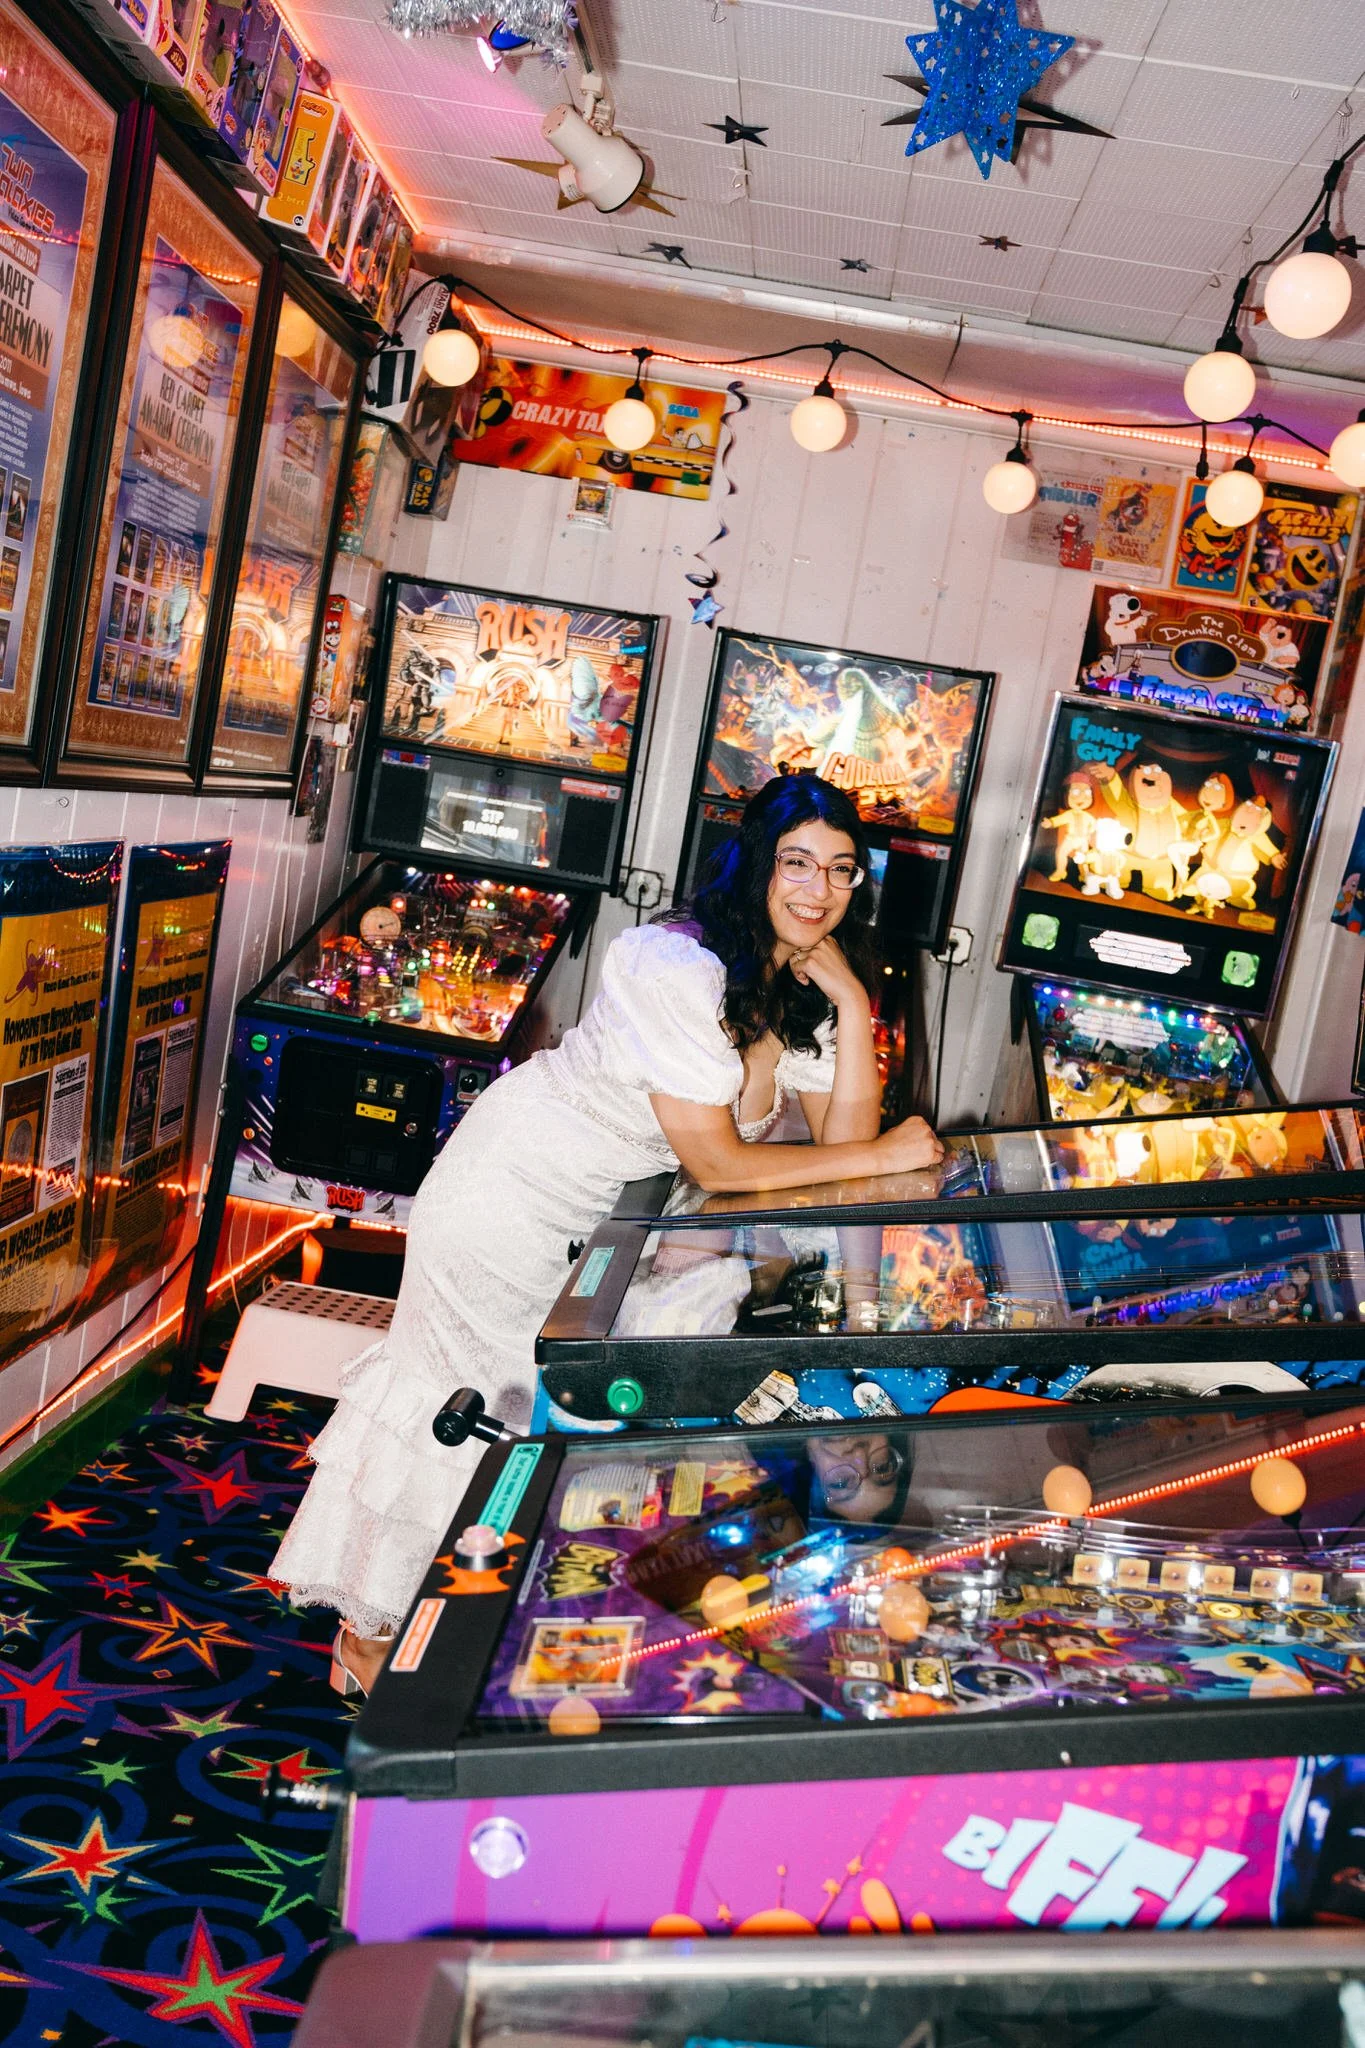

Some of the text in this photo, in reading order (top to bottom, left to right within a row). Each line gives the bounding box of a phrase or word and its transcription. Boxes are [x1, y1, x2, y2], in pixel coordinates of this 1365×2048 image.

[0, 169, 55, 236] ALAXIES
[512, 400, 575, 428] CRAZY
[667, 403, 699, 418] SEGA
[1324, 527, 1341, 545] 3
[475, 602, 572, 669] RUSH
[1200, 615, 1224, 628] The
[1159, 627, 1257, 659] Drunken Clam
[1070, 716, 1142, 751] FAMILY
[1076, 743, 1122, 767] GUY
[823, 752, 906, 790] GODZILLA
[326, 1185, 366, 1212] RUSH
[942, 1801, 1250, 1932] BIFF!
